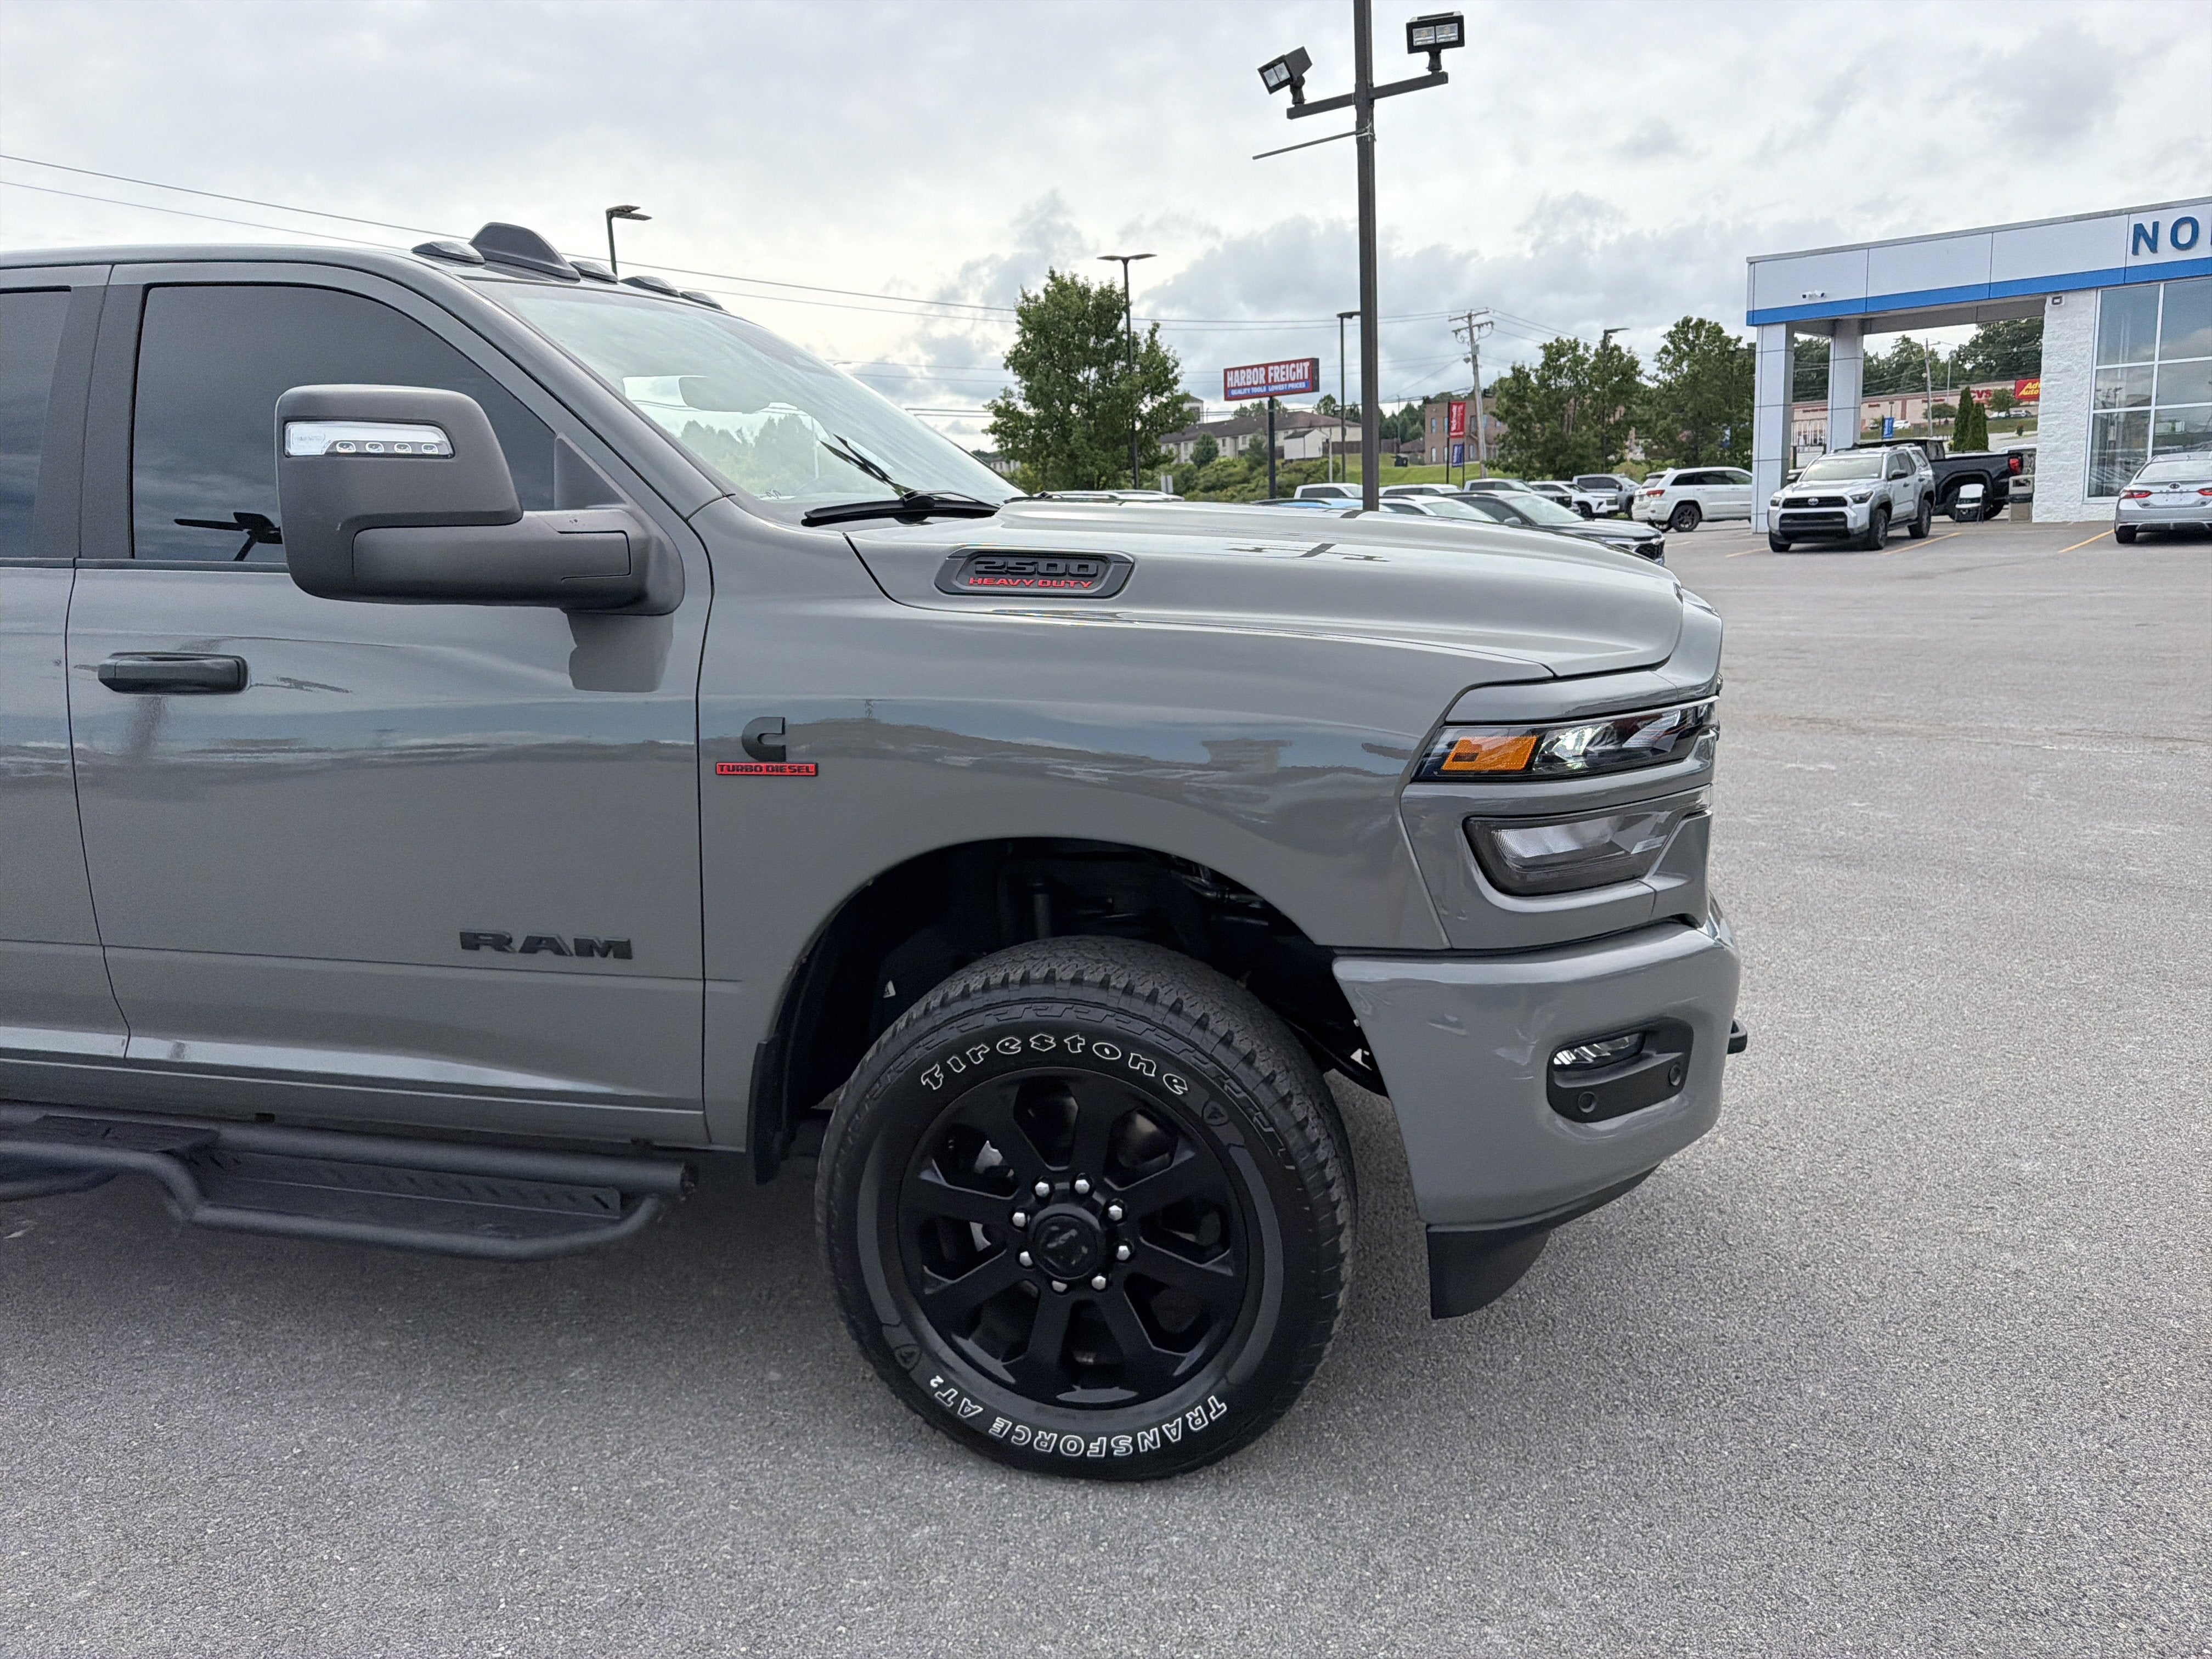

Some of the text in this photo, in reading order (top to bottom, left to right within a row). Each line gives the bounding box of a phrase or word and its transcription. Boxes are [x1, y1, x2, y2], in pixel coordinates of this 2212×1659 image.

[2131, 216, 2212, 256] NO
[1227, 362, 1310, 387] HARBOR FREIGHT
[974, 560, 1097, 577] 2500
[968, 577, 1093, 589] HEAVY DUTY
[718, 764, 814, 773] TURBO DIESEL
[459, 932, 633, 960] RAM
[921, 1034, 1189, 1095] Firestone
[989, 1395, 1228, 1458] TRANSFORCE
